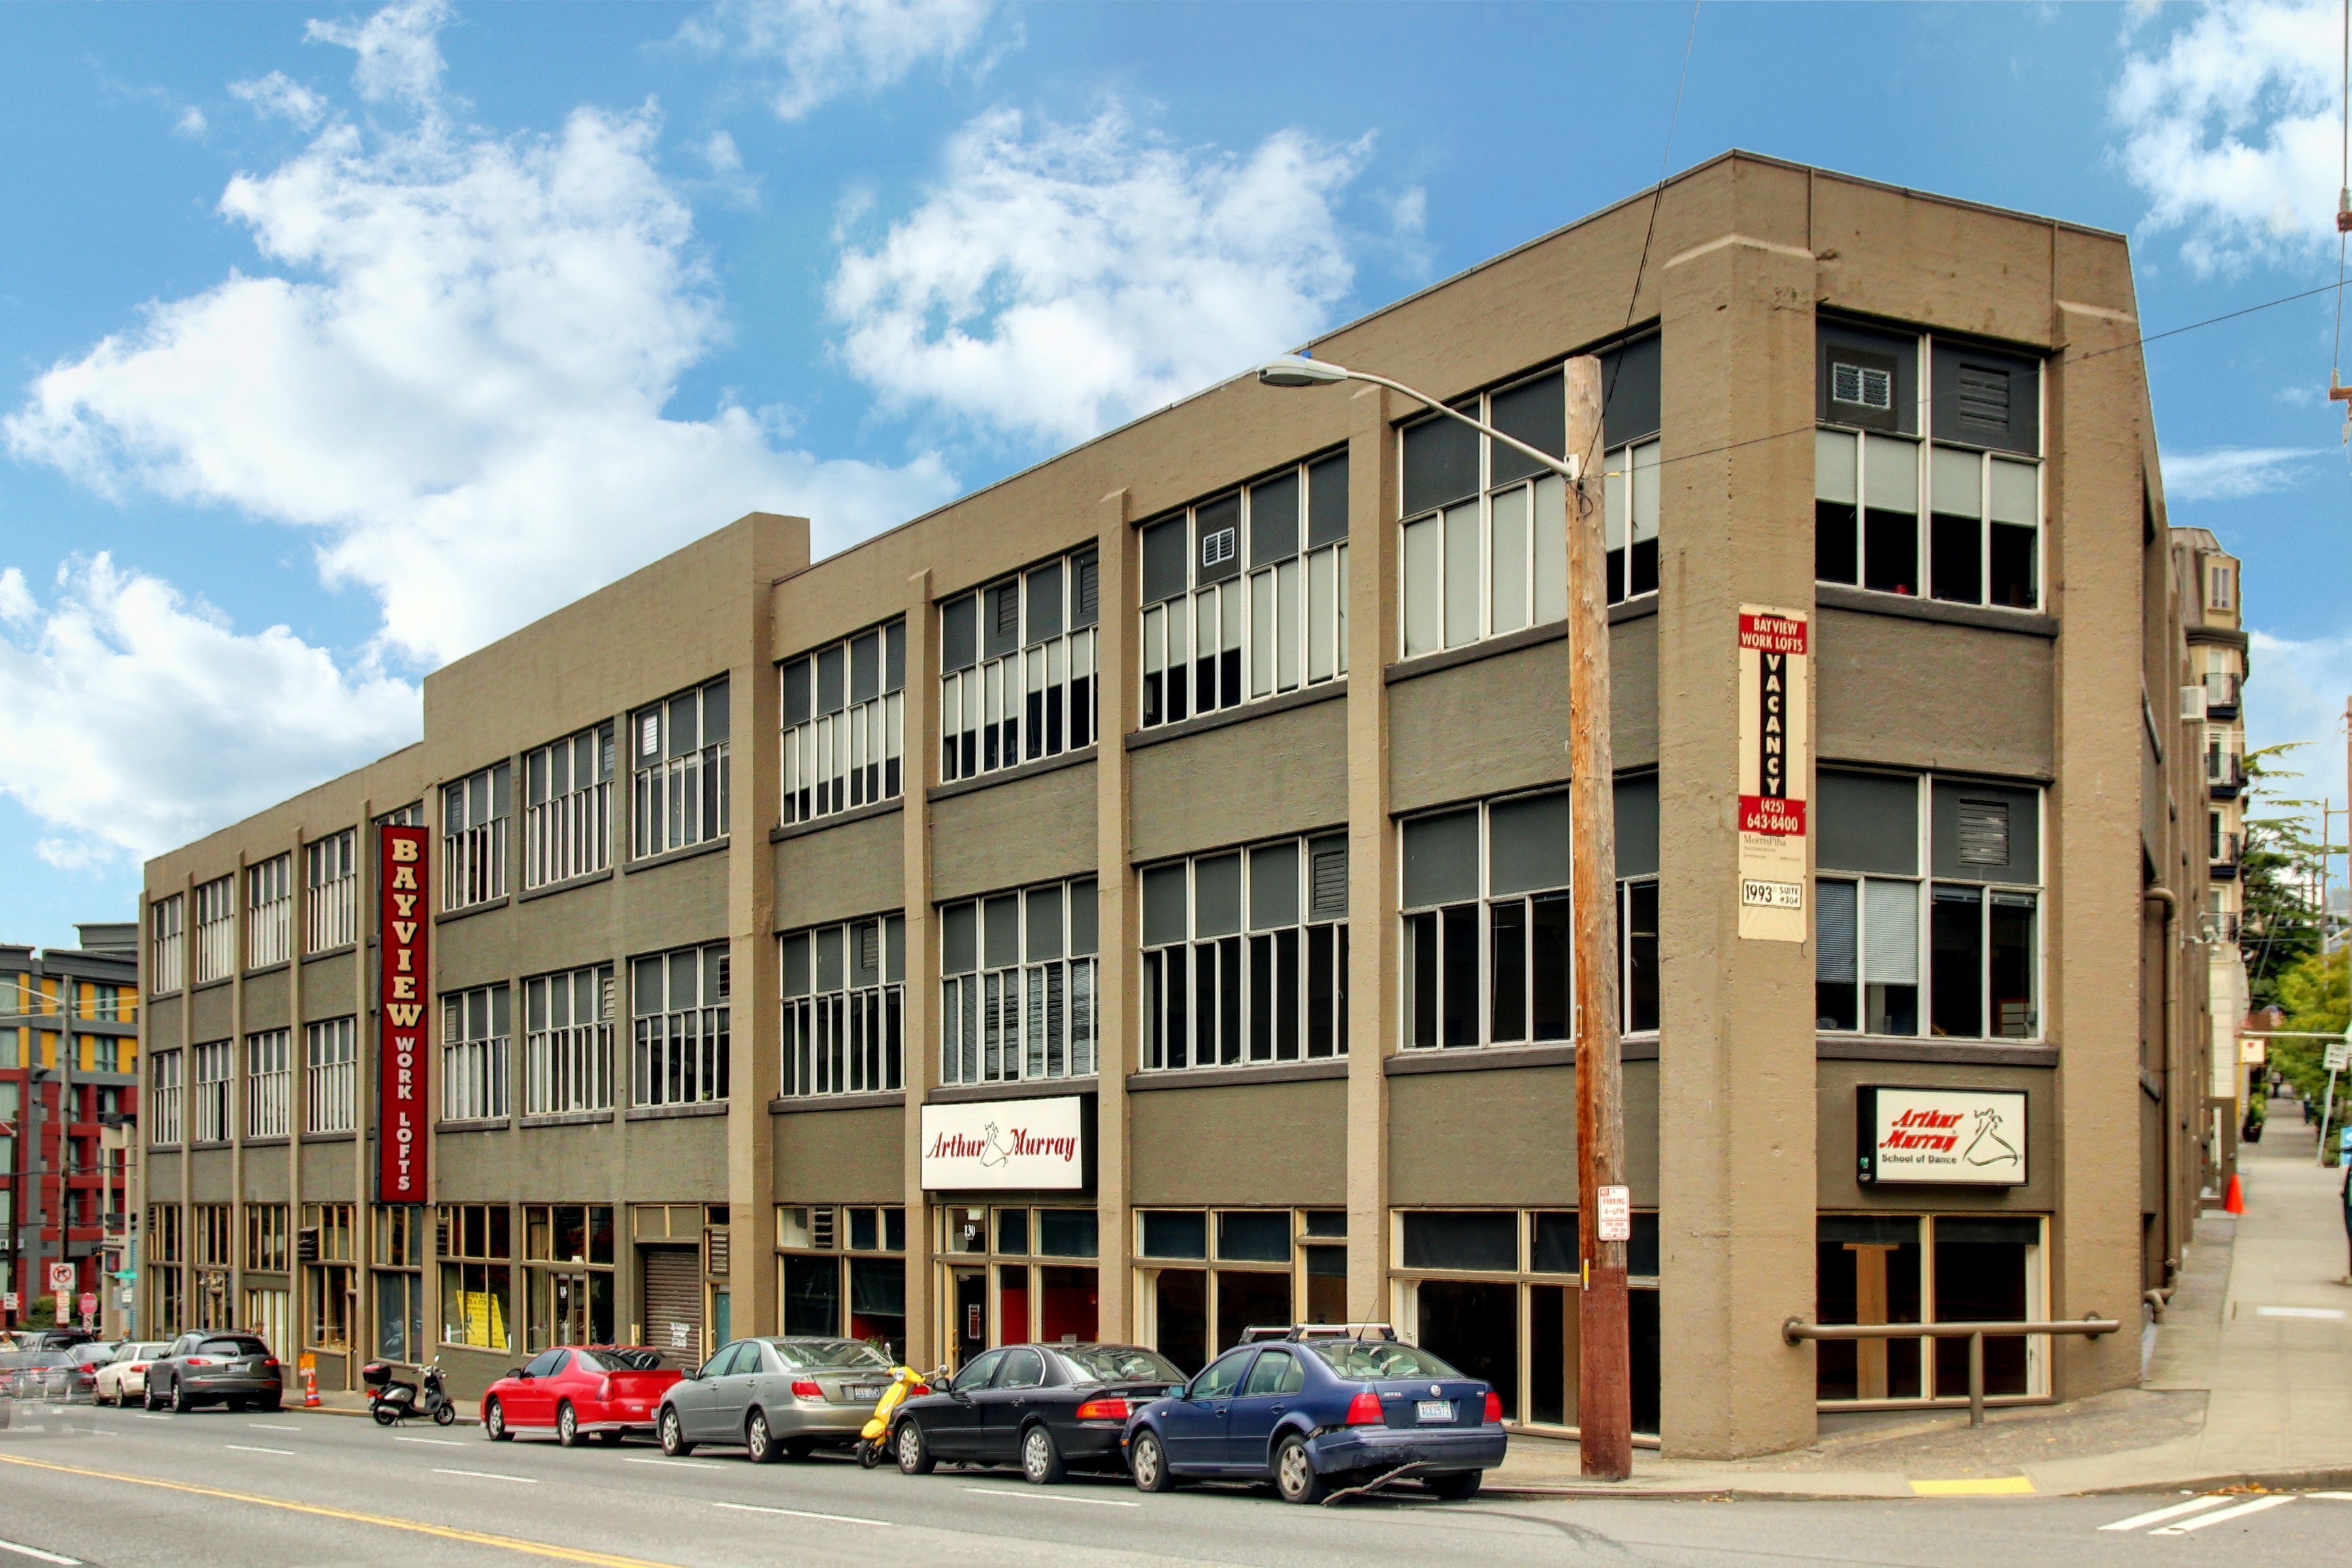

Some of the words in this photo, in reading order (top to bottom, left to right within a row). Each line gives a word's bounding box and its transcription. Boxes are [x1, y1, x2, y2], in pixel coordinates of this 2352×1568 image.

[1754, 618, 1797, 636] BAYVIEW
[1742, 632, 1772, 649] WORK
[1776, 636, 1803, 652] LOFTS
[1765, 653, 1780, 796] VACANCY
[1761, 798, 1784, 814] (425)
[1745, 885, 1772, 902] 1993
[1779, 886, 1799, 895] SUITE
[387, 838, 423, 1027] BAYVIEW
[395, 1036, 415, 1100] WORK
[1891, 1109, 1963, 1128] Arthur
[396, 1111, 412, 1191] LOFTS
[926, 1132, 985, 1158] Arthur
[1005, 1128, 1076, 1162] Murray
[1879, 1130, 1959, 1152] Murray
[1882, 1154, 1913, 1164] School
[1916, 1154, 1925, 1163] of
[1929, 1154, 1957, 1164] Dance
